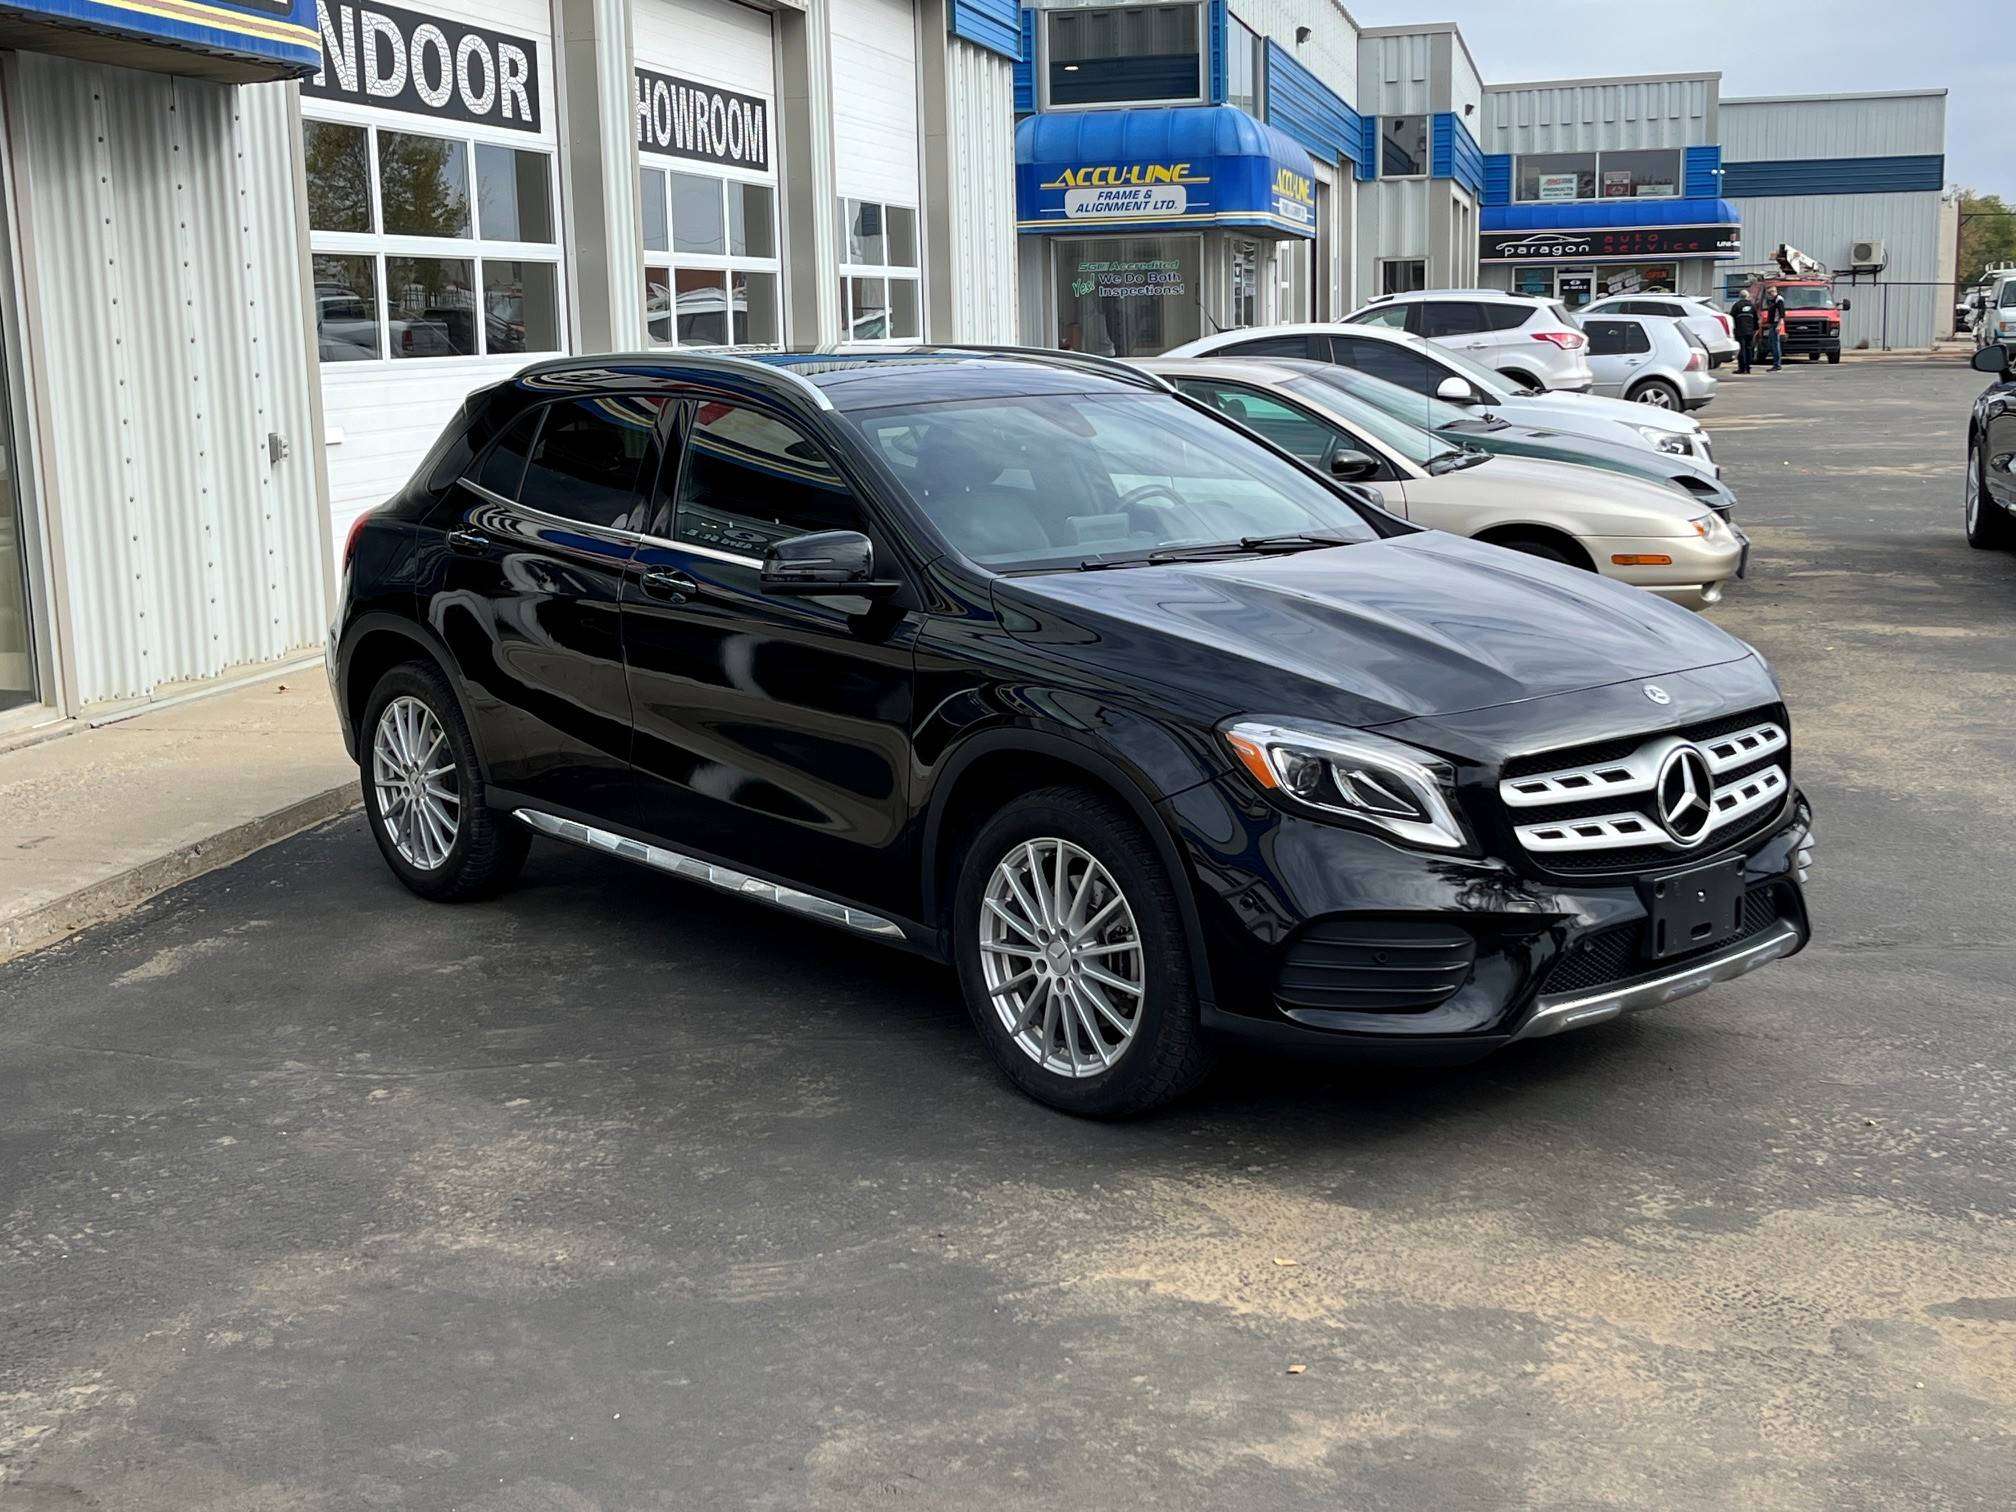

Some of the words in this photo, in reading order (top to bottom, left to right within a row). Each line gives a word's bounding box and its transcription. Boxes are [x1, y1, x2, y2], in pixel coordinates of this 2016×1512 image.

[311, 0, 533, 123] NDOOR
[634, 76, 764, 163] HOWROOM
[1054, 163, 1191, 187] ACCU-LINE
[1097, 190, 1140, 201] FRAME
[1144, 189, 1153, 200] &
[1075, 201, 1149, 213] ALIGNMENT
[1153, 199, 1178, 210] LTD.
[1504, 244, 1590, 257] paragon
[1098, 273, 1122, 285] We
[1124, 272, 1145, 284] Do
[1147, 271, 1183, 283] Both
[1098, 284, 1184, 298] Inspections!
